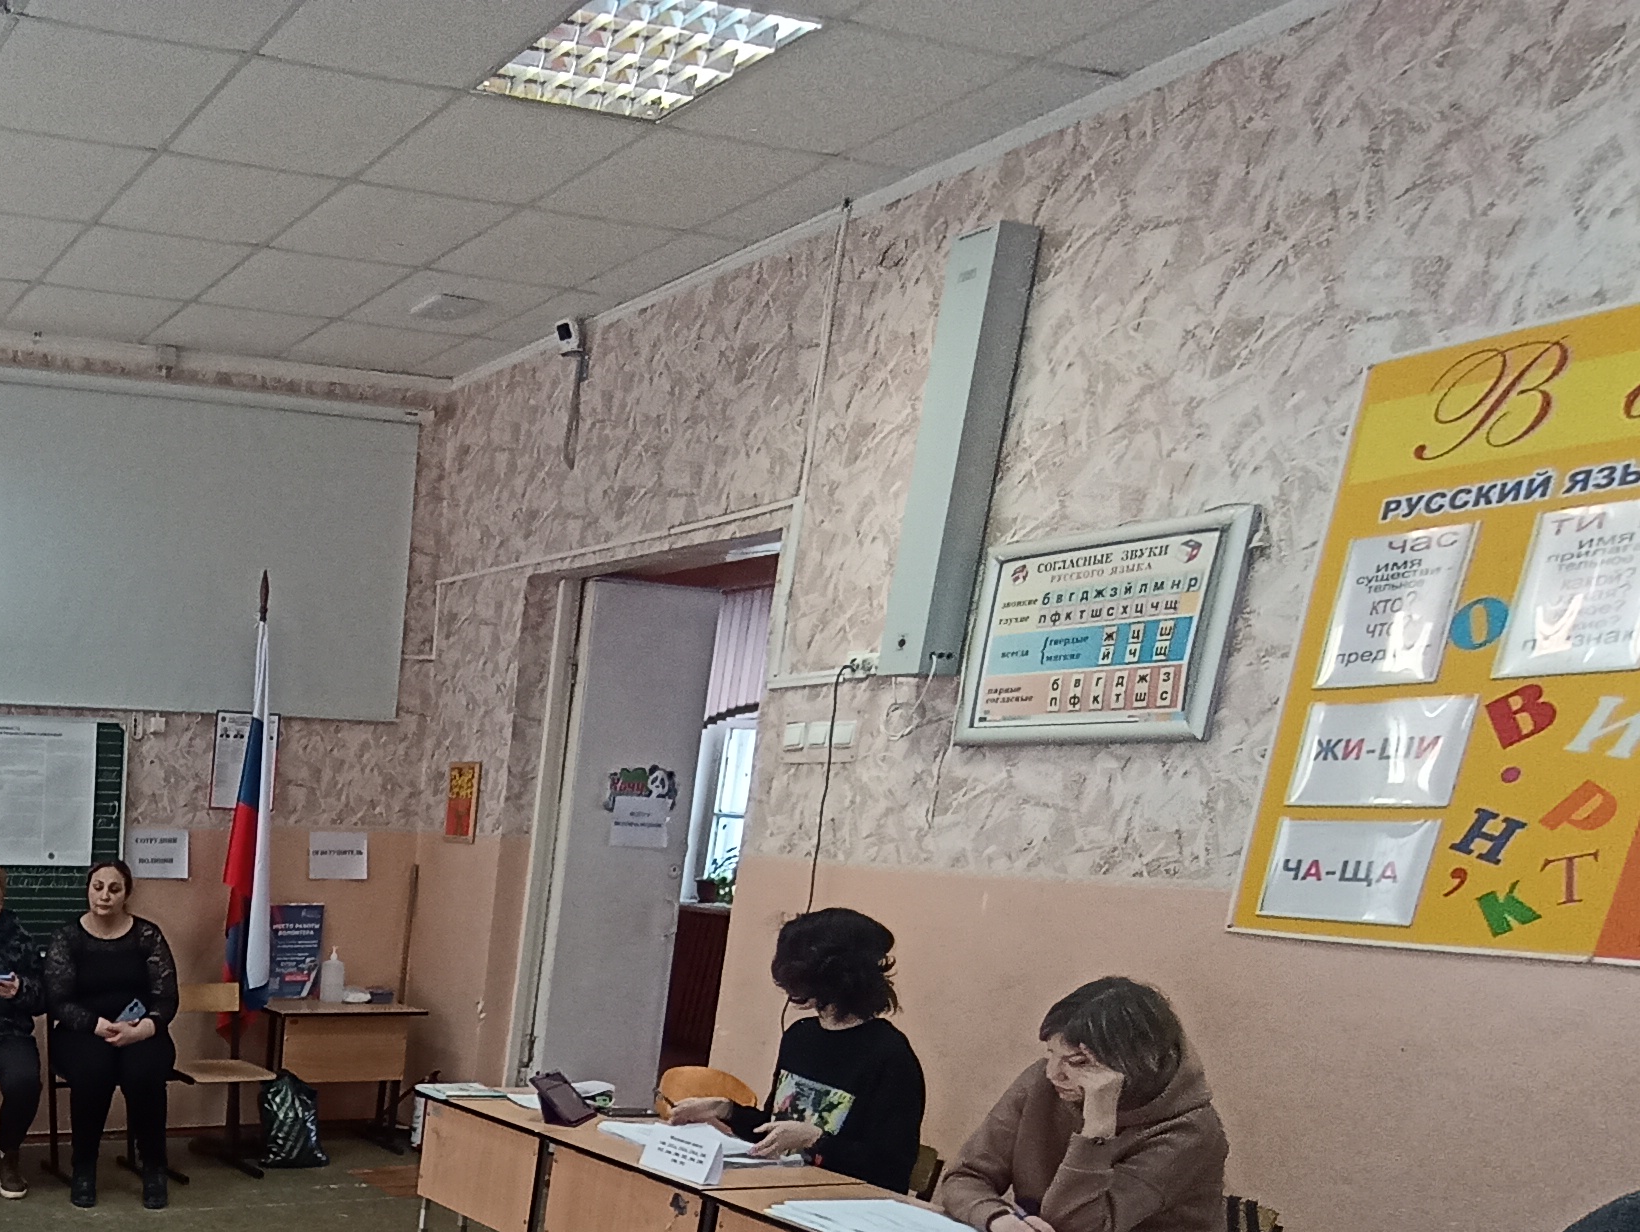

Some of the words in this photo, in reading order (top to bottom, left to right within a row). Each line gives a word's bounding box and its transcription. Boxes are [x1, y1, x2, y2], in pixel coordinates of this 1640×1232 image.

[1413, 334, 1570, 460] В
[1379, 470, 1555, 522] РУССКИЙ
[1037, 553, 1114, 574] СОГЛАСНЫЕ
[1120, 544, 1170, 561] ЗВУКИ
[1050, 569, 1105, 583] РУССКОГО
[1109, 562, 1153, 576] ЯЗЫКА
[1485, 684, 1557, 750] В
[1313, 735, 1443, 761] ЖИ-ШИ
[1538, 779, 1618, 831] Р
[1449, 807, 1528, 866] Н
[1281, 858, 1399, 887] ЧА-ЩА
[1540, 849, 1600, 906] Т
